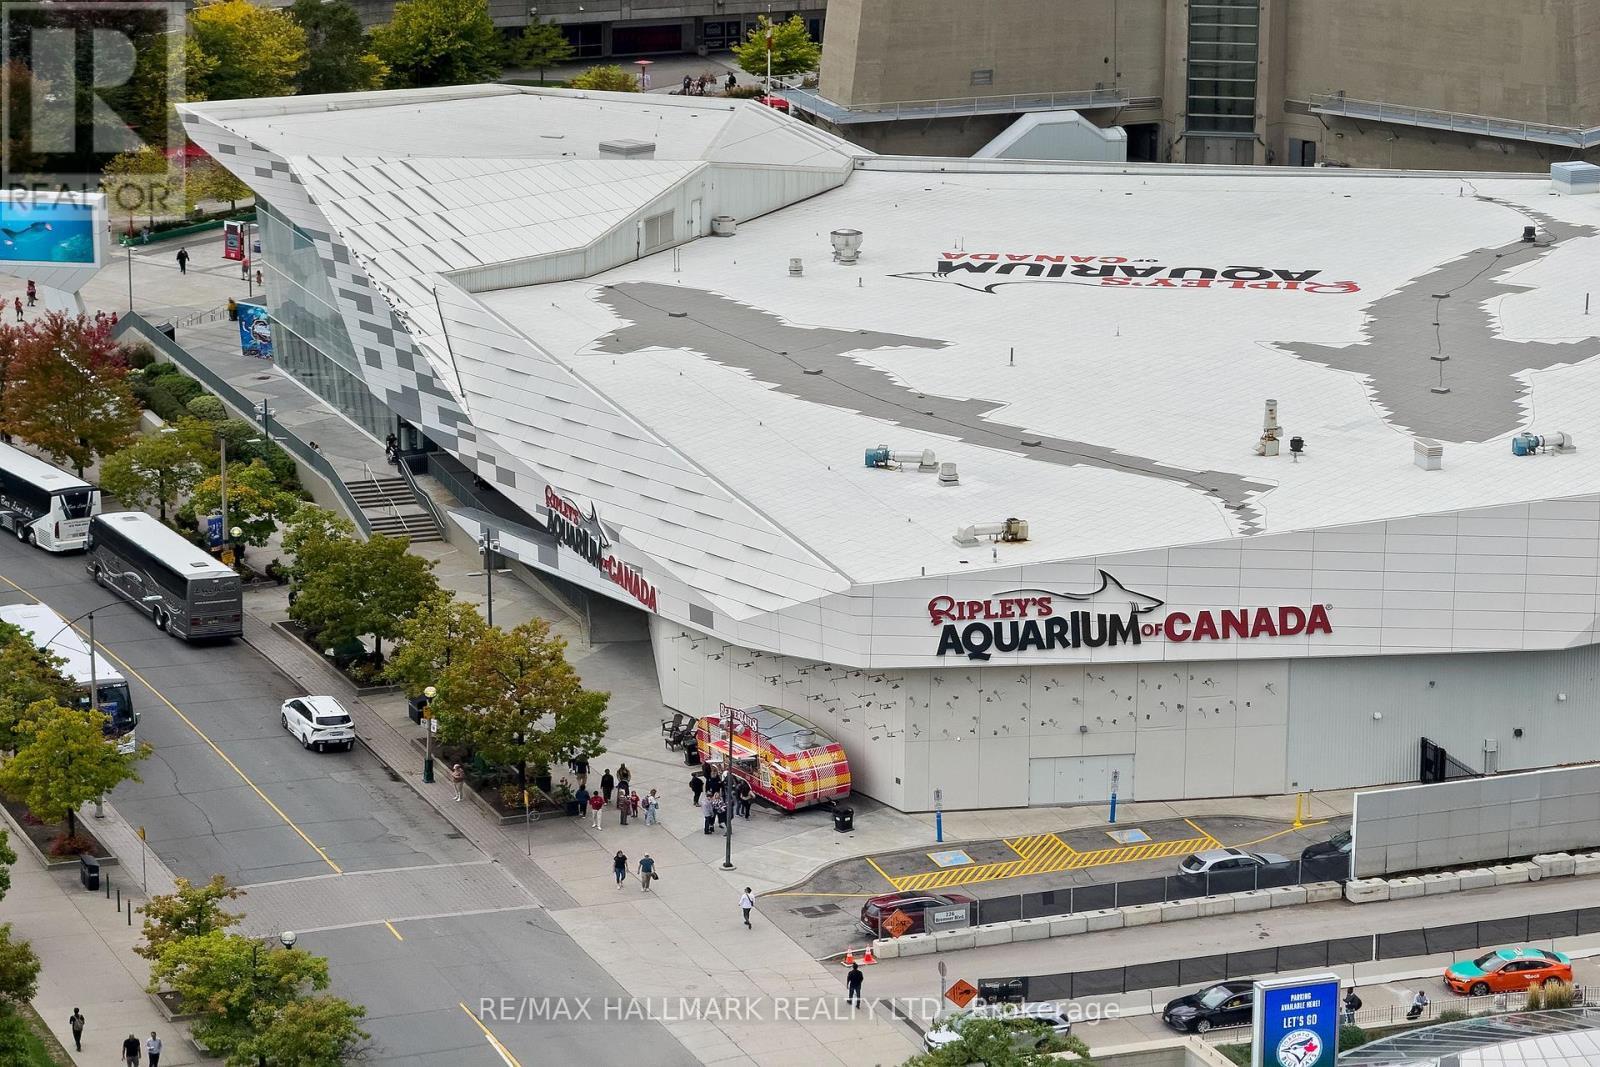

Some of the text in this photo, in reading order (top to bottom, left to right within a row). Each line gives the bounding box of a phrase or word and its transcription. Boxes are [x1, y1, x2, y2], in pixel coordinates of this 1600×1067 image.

[942, 252, 1127, 264] CANADA
[937, 261, 1322, 281] AQUARIUM
[1101, 277, 1361, 294] RIPLEY'S
[545, 485, 579, 526] RIPLEY'S
[547, 508, 602, 572] AQUARIUM
[609, 555, 657, 613] CANADA
[927, 595, 1053, 626] RIPLEY'S
[936, 604, 1333, 660] AQUARIUM OF CANADA
[1290, 992, 1312, 1002] PARKING
[1281, 1001, 1305, 1011] AVAILABLE
[1283, 1014, 1318, 1028] LET'S GO
[1282, 1032, 1310, 1047] TORONTO
